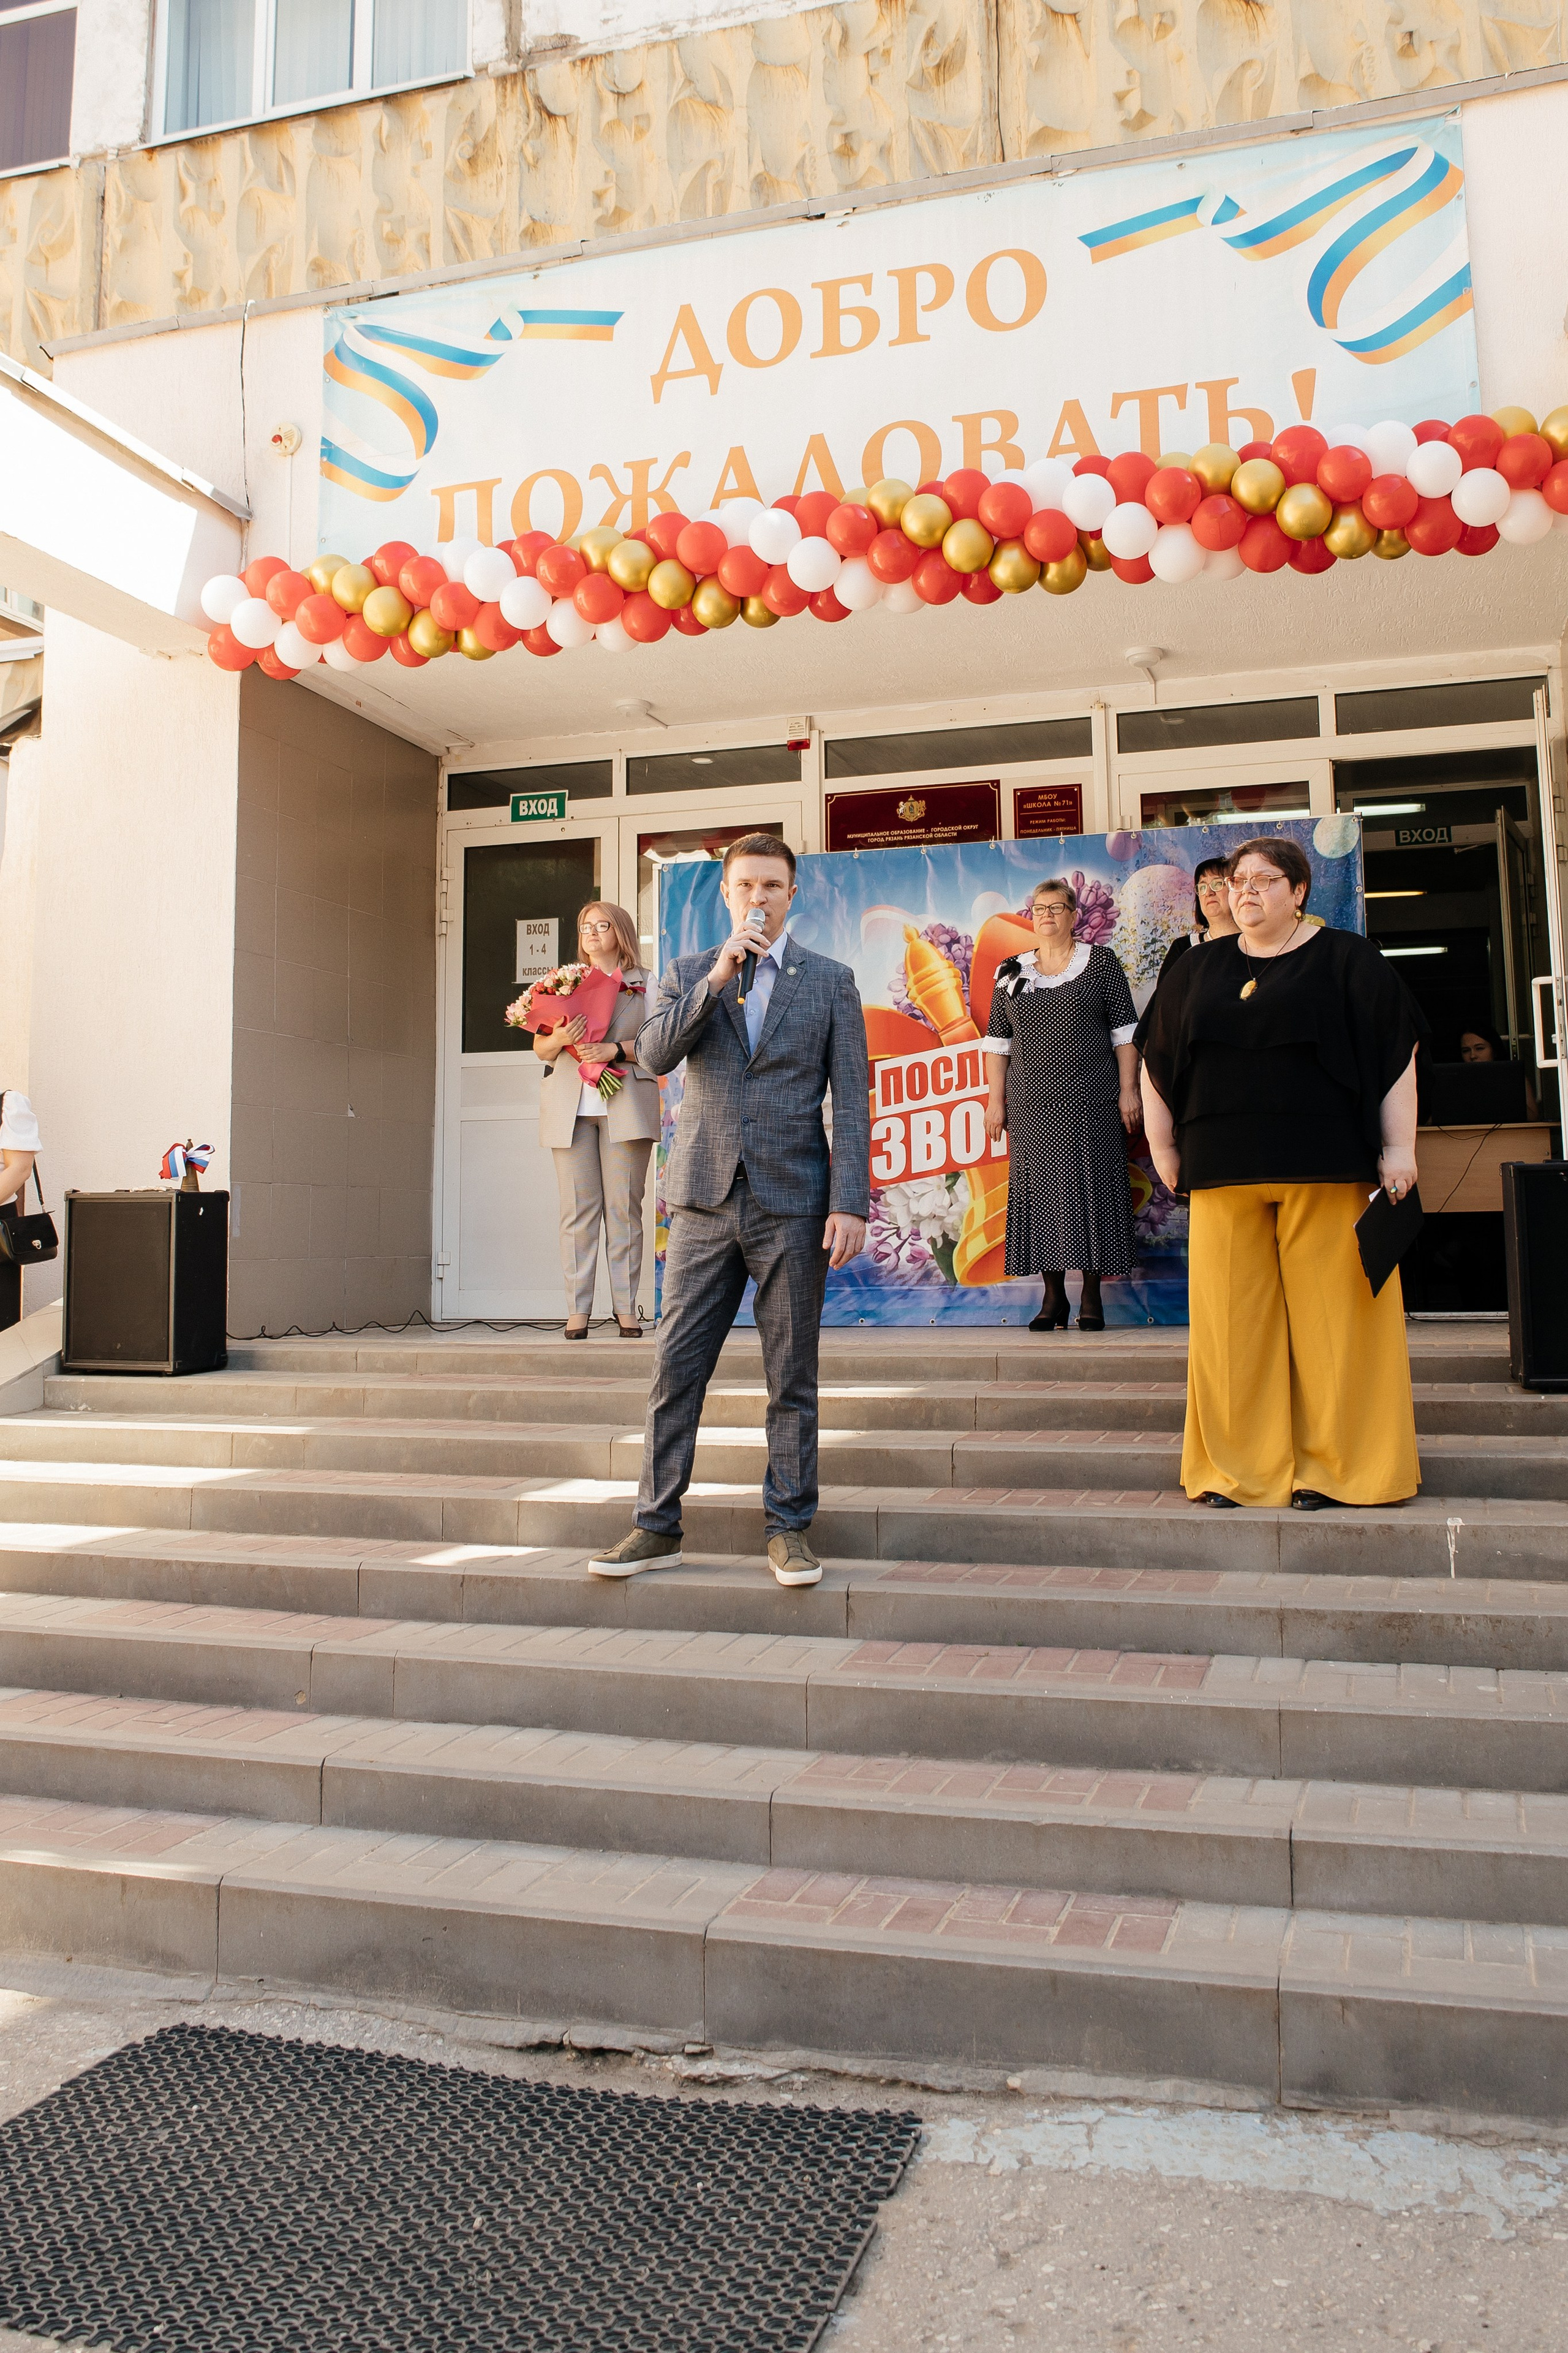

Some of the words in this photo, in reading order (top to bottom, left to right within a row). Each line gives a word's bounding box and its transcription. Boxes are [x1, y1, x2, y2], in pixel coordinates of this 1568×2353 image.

[650, 248, 1047, 404] ДОБРО
[519, 798, 558, 817] ВХОД
[1399, 827, 1448, 843] ВХОД
[526, 923, 549, 936] ВХОД
[881, 1049, 989, 1107] ПОСЛ
[871, 1100, 1008, 1180] ЗВО
